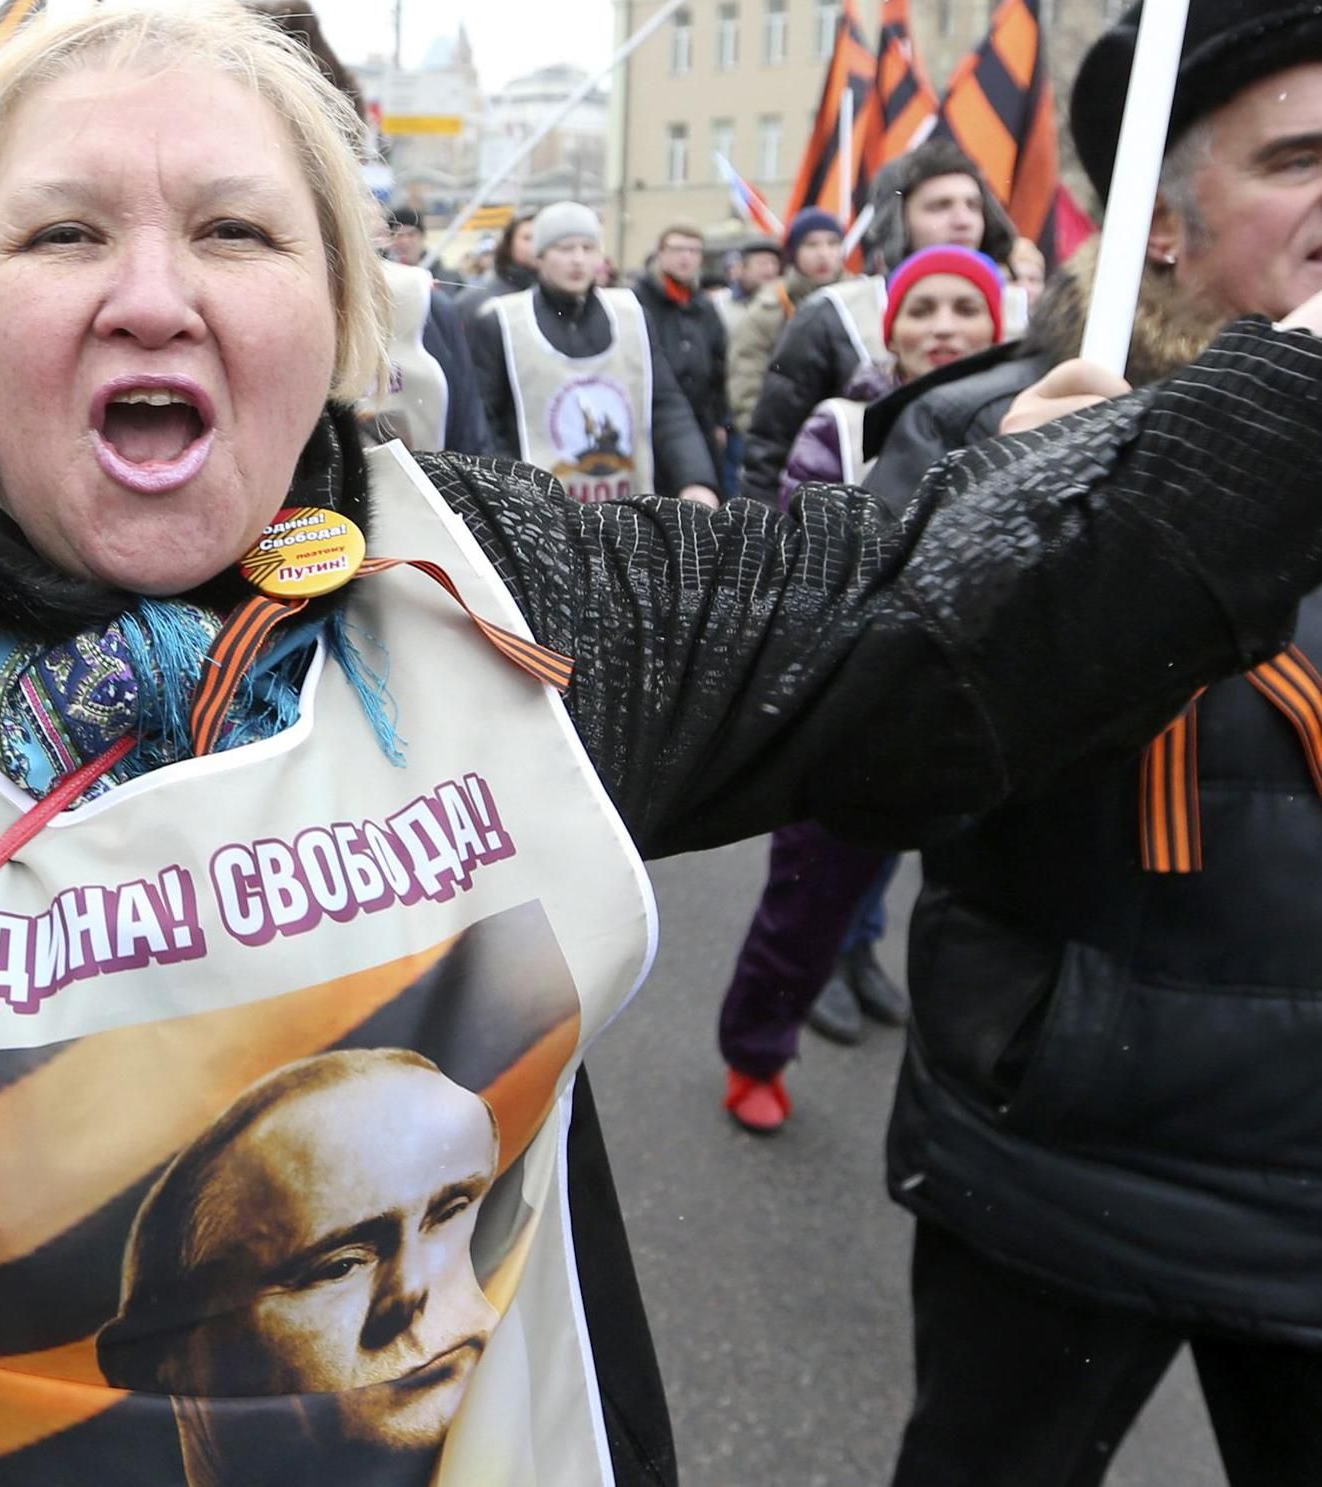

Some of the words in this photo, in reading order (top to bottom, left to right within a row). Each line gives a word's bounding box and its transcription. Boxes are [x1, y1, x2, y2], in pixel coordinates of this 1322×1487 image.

[259, 524, 347, 551] Свобода!
[261, 514, 326, 535] одина!
[278, 556, 347, 581] Путин!
[209, 772, 516, 948] СВОБОДА!
